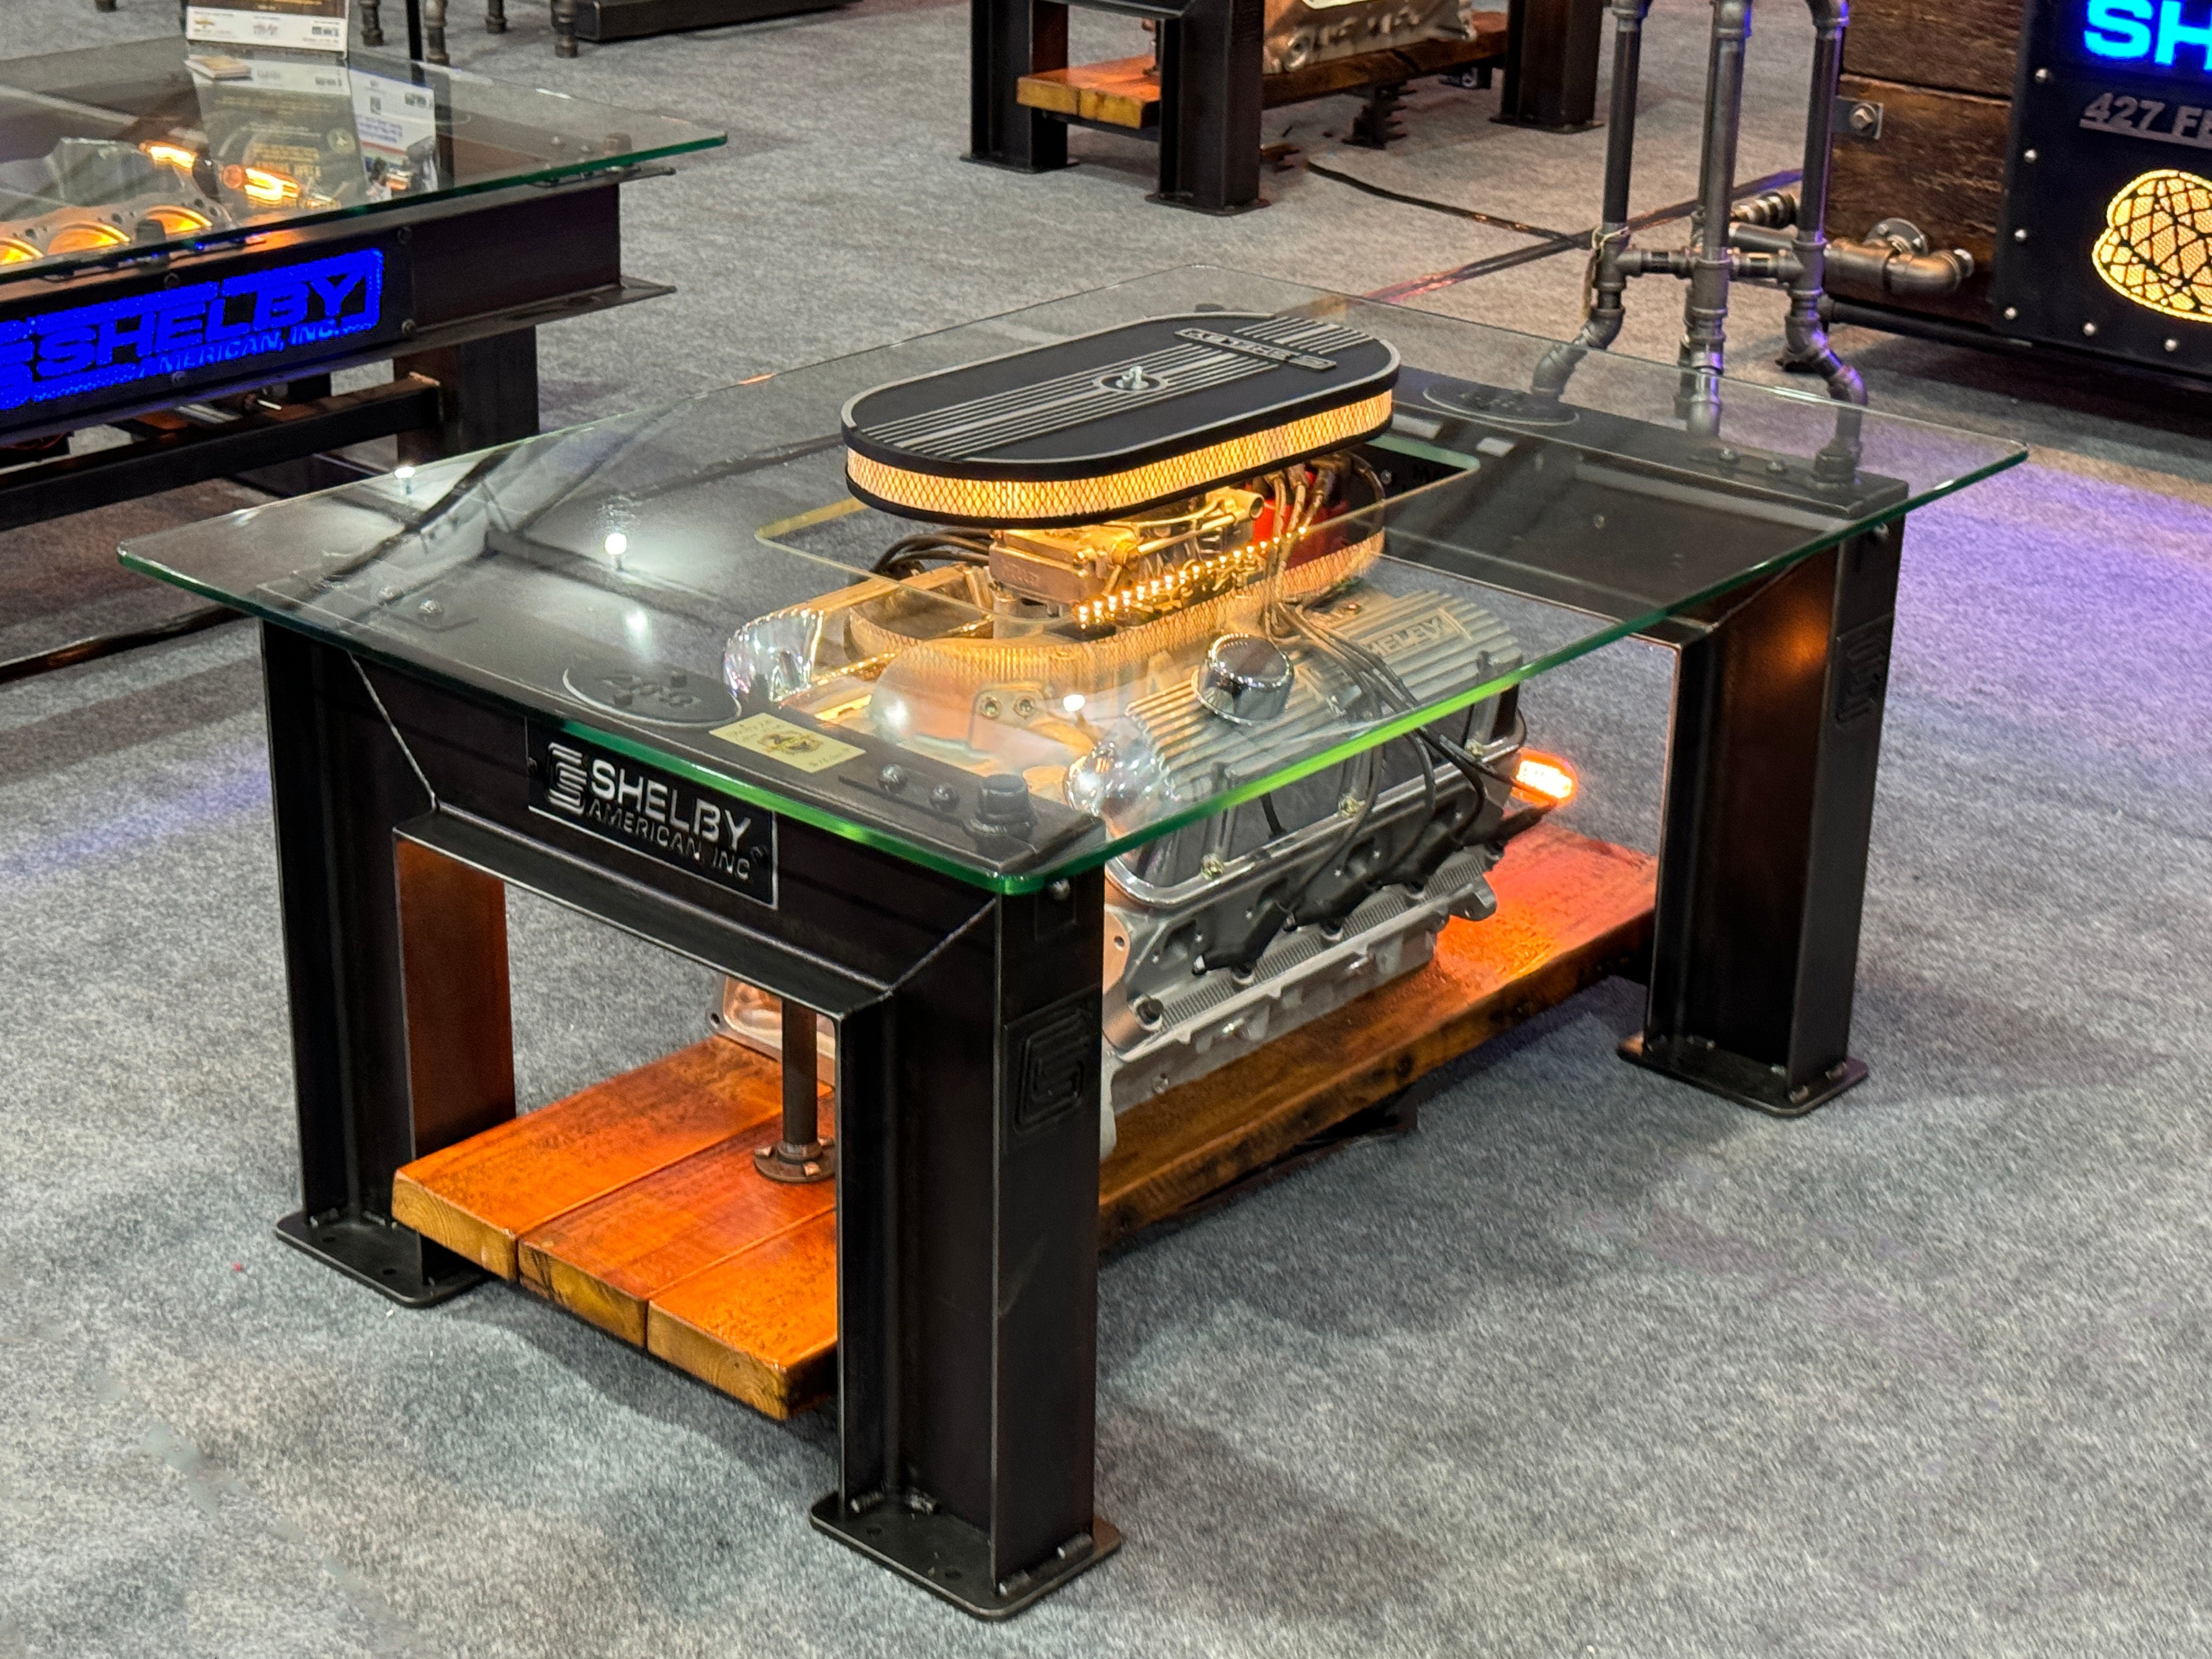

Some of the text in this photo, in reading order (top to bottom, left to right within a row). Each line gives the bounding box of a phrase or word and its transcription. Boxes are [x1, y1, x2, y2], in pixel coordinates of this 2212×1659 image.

[2083, 0, 2212, 71] SH
[2084, 92, 2166, 132] 427
[37, 271, 365, 376] SHELBY
[591, 758, 752, 852] SHELBY
